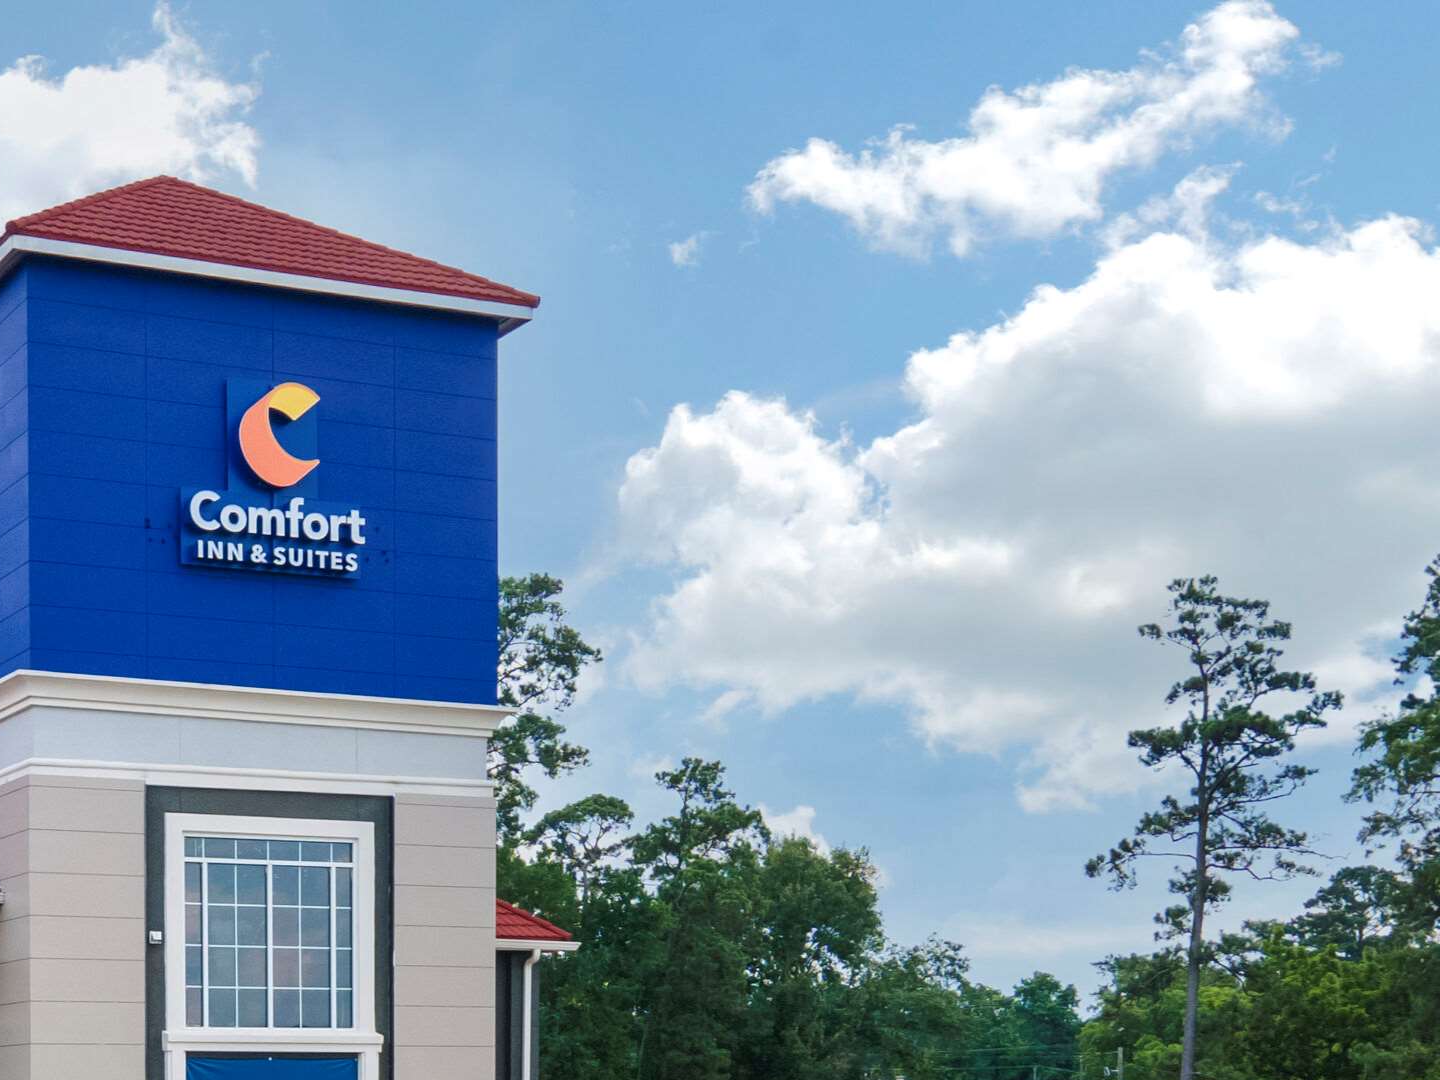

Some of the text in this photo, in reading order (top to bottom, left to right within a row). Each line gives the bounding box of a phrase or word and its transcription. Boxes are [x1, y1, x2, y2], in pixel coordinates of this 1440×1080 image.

[189, 489, 366, 545] Comfort
[196, 539, 359, 572] INN & SUITES
